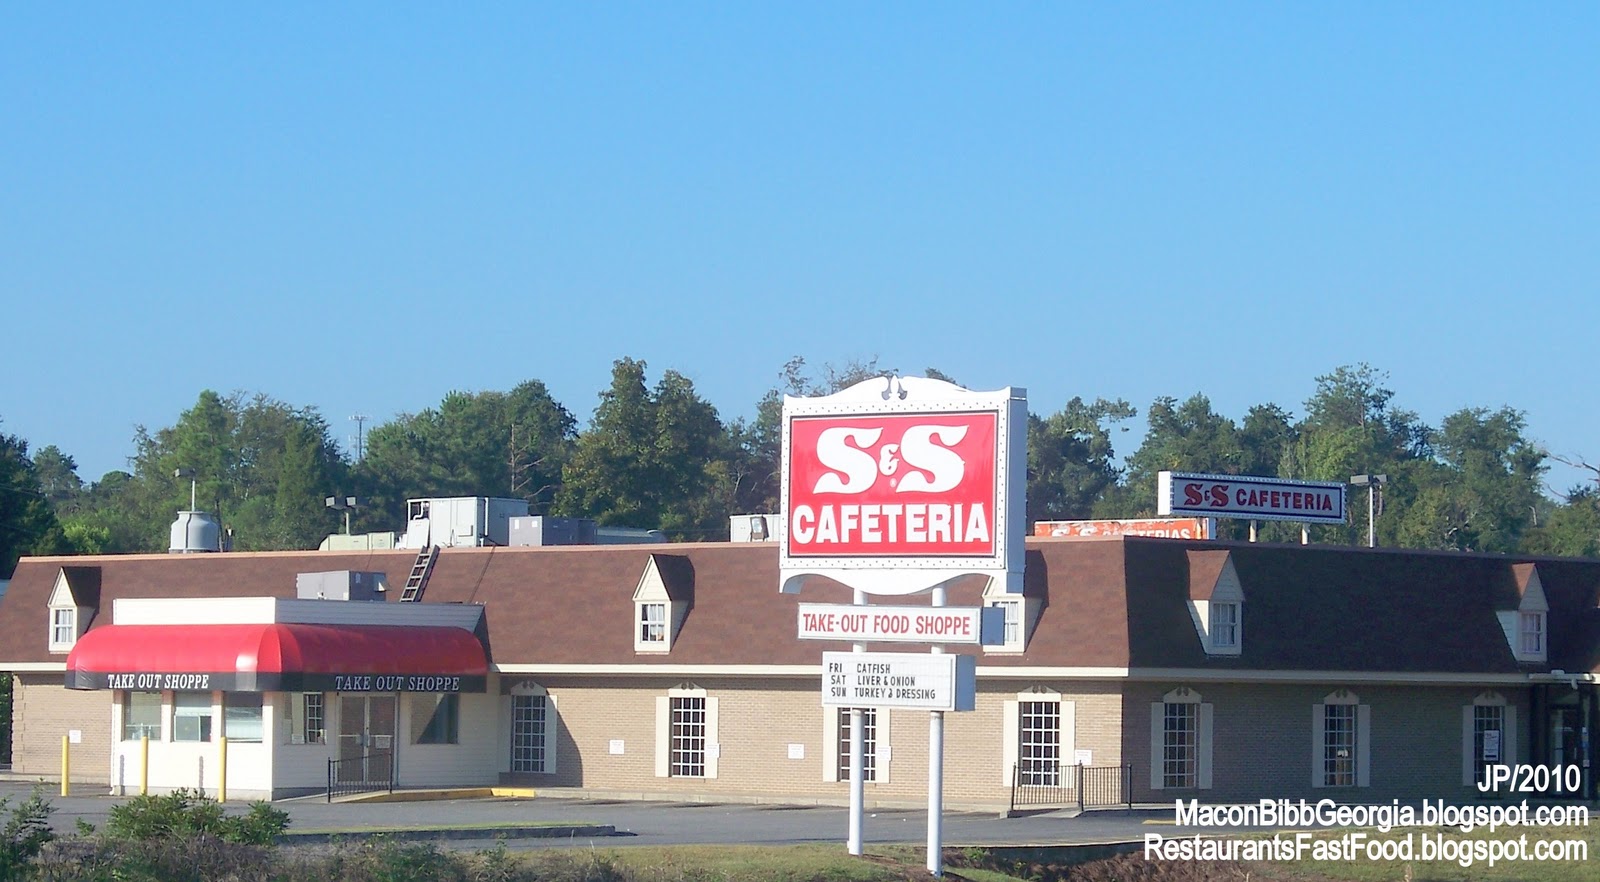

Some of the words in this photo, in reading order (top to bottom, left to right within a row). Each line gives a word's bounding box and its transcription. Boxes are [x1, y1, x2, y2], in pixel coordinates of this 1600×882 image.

[813, 424, 969, 494] S&S
[1184, 483, 1230, 507] S&S
[1236, 488, 1333, 511] CAFETERIA
[792, 502, 990, 544] CAFETERIA
[803, 613, 868, 633] TAKE-OUT
[873, 614, 910, 634] FOOD
[915, 615, 971, 635] SHOPPE
[829, 662, 843, 673] FRI
[856, 663, 891, 674] CATFISH
[107, 674, 135, 689] TAKE
[137, 674, 162, 689] OUT
[164, 674, 210, 689] SHOPPE
[335, 675, 371, 690] TAKE
[376, 676, 404, 690] OUT
[408, 676, 460, 691] SHOPPE
[830, 675, 847, 685] SAT
[857, 675, 881, 686] LIVER
[883, 675, 888, 686] &
[890, 676, 916, 687] ONION
[830, 687, 847, 697] SUN
[854, 687, 886, 698] TURKEY
[896, 688, 936, 700] DRESSING
